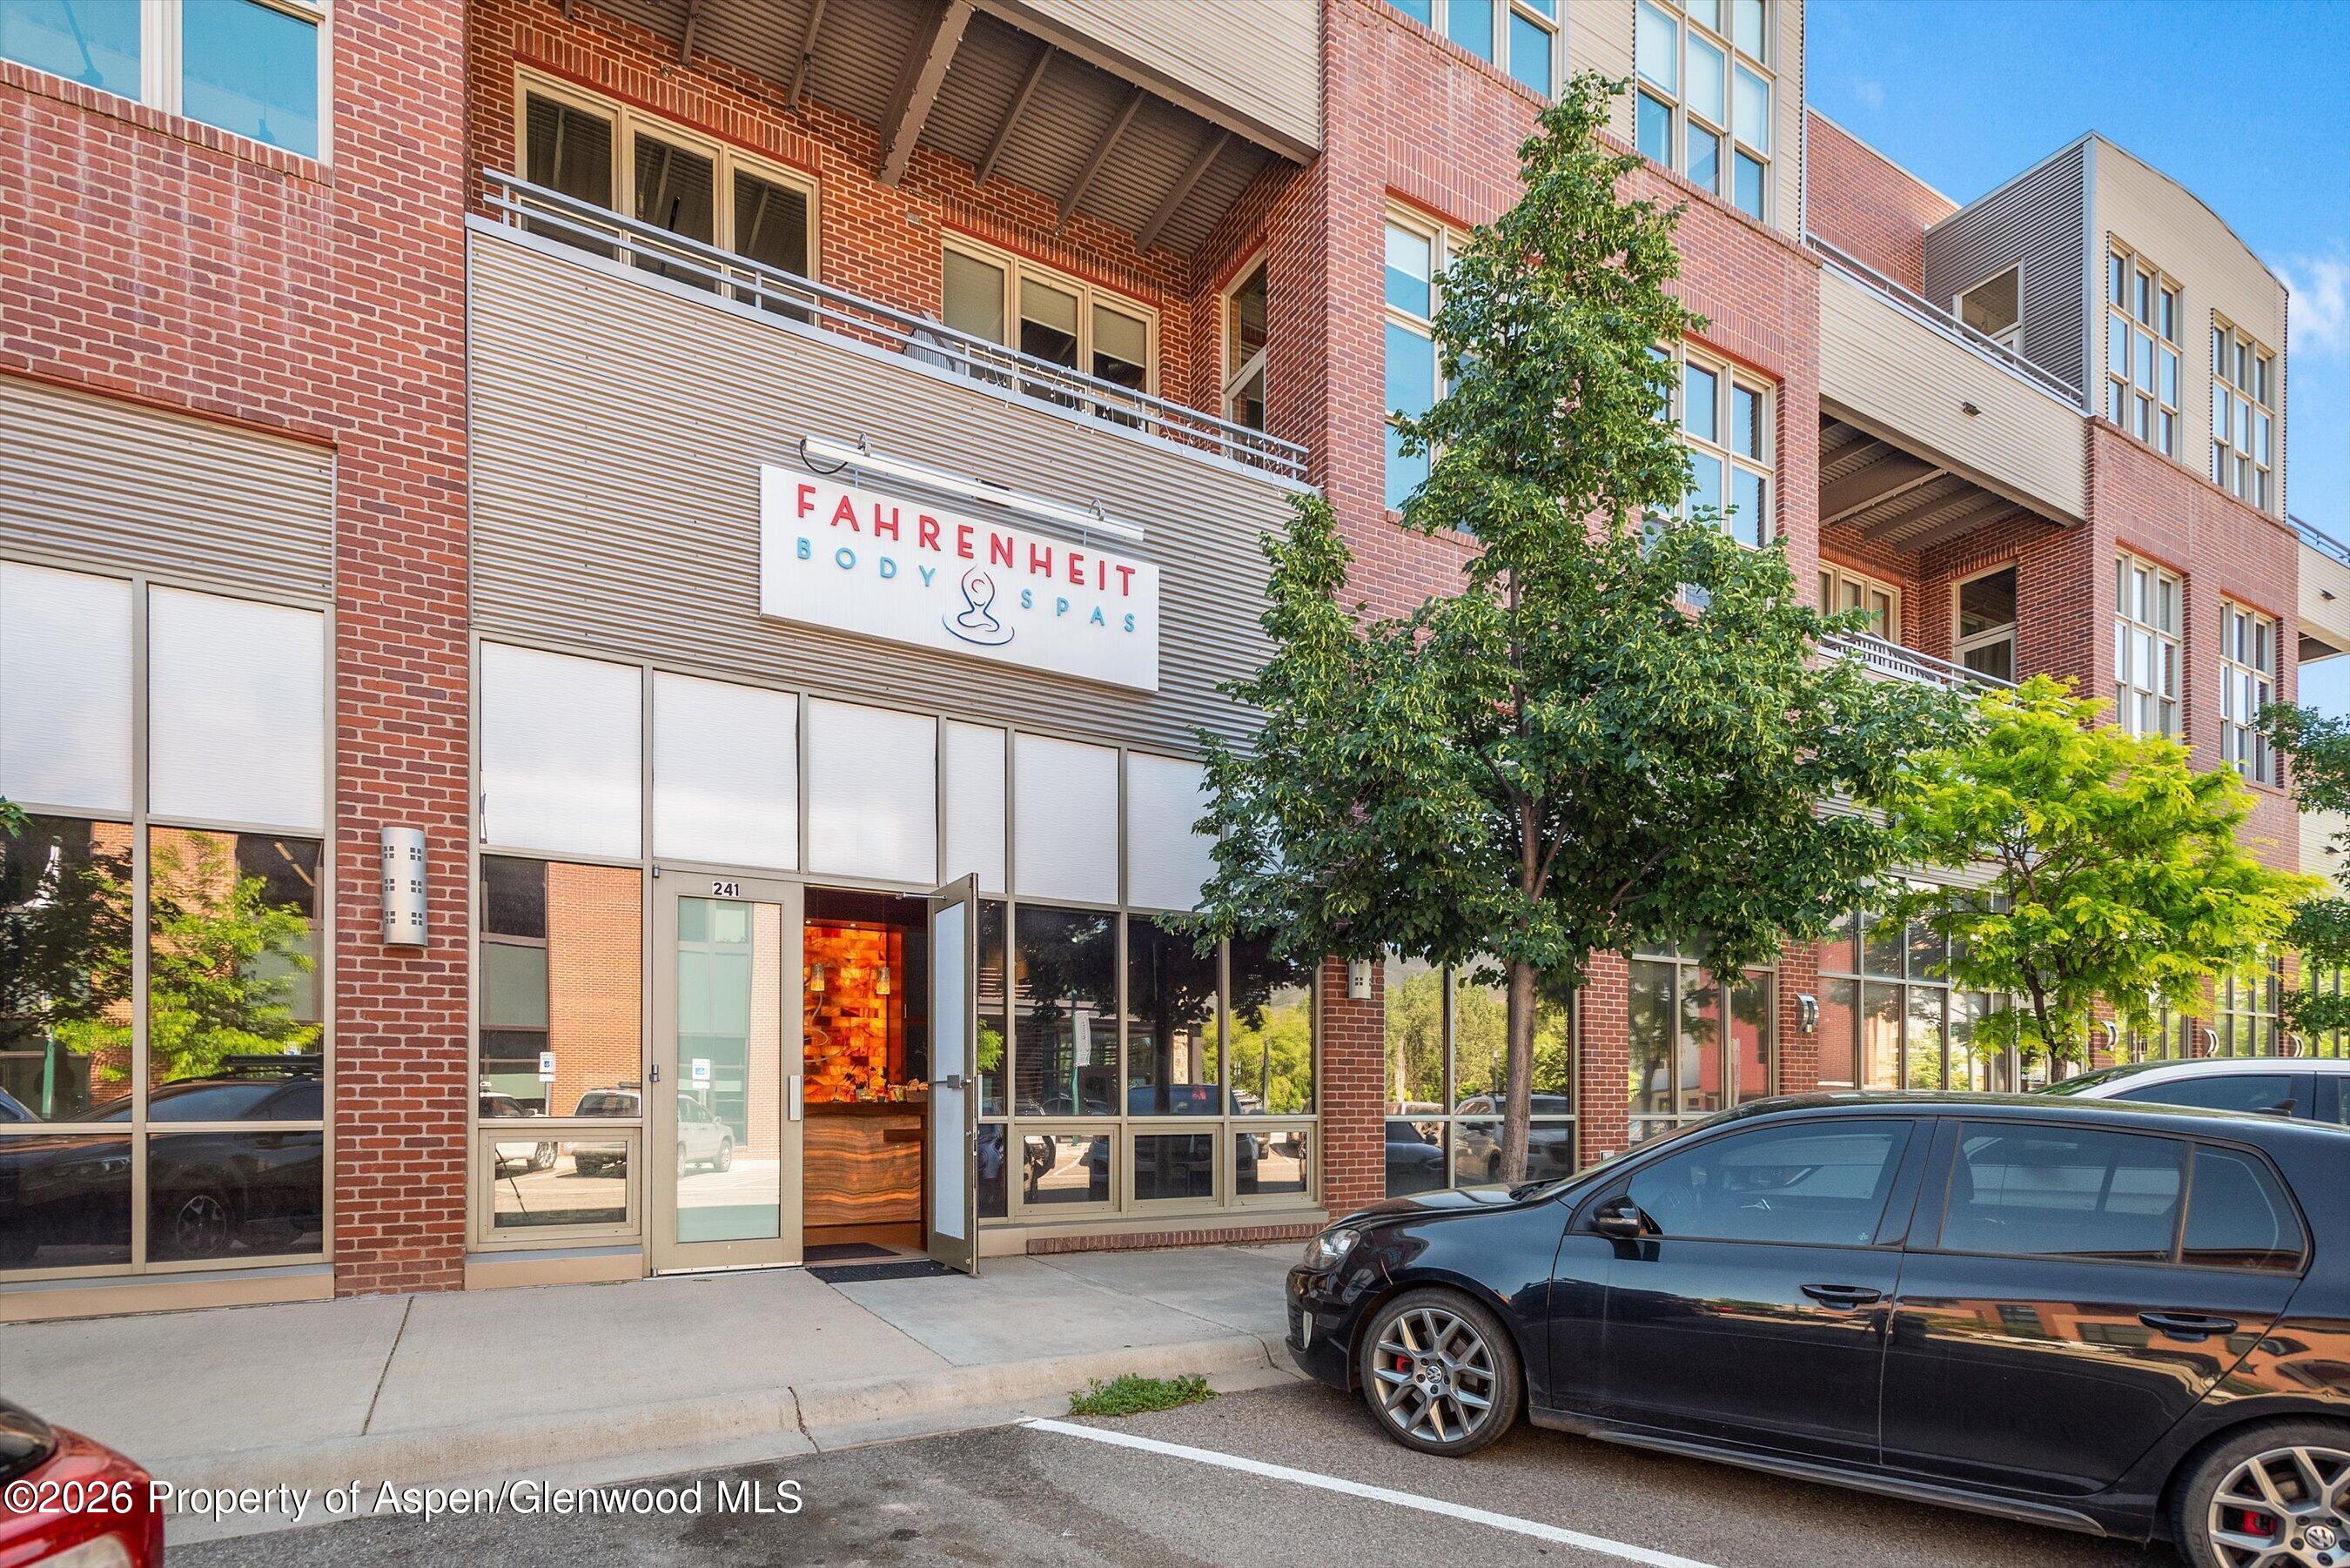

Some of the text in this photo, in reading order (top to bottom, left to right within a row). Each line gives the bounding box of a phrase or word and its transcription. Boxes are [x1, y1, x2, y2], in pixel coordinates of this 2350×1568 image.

[796, 483, 1136, 596] FAHRENHEIT
[796, 536, 1136, 633] BODY SPAS
[713, 881, 739, 896] 241
